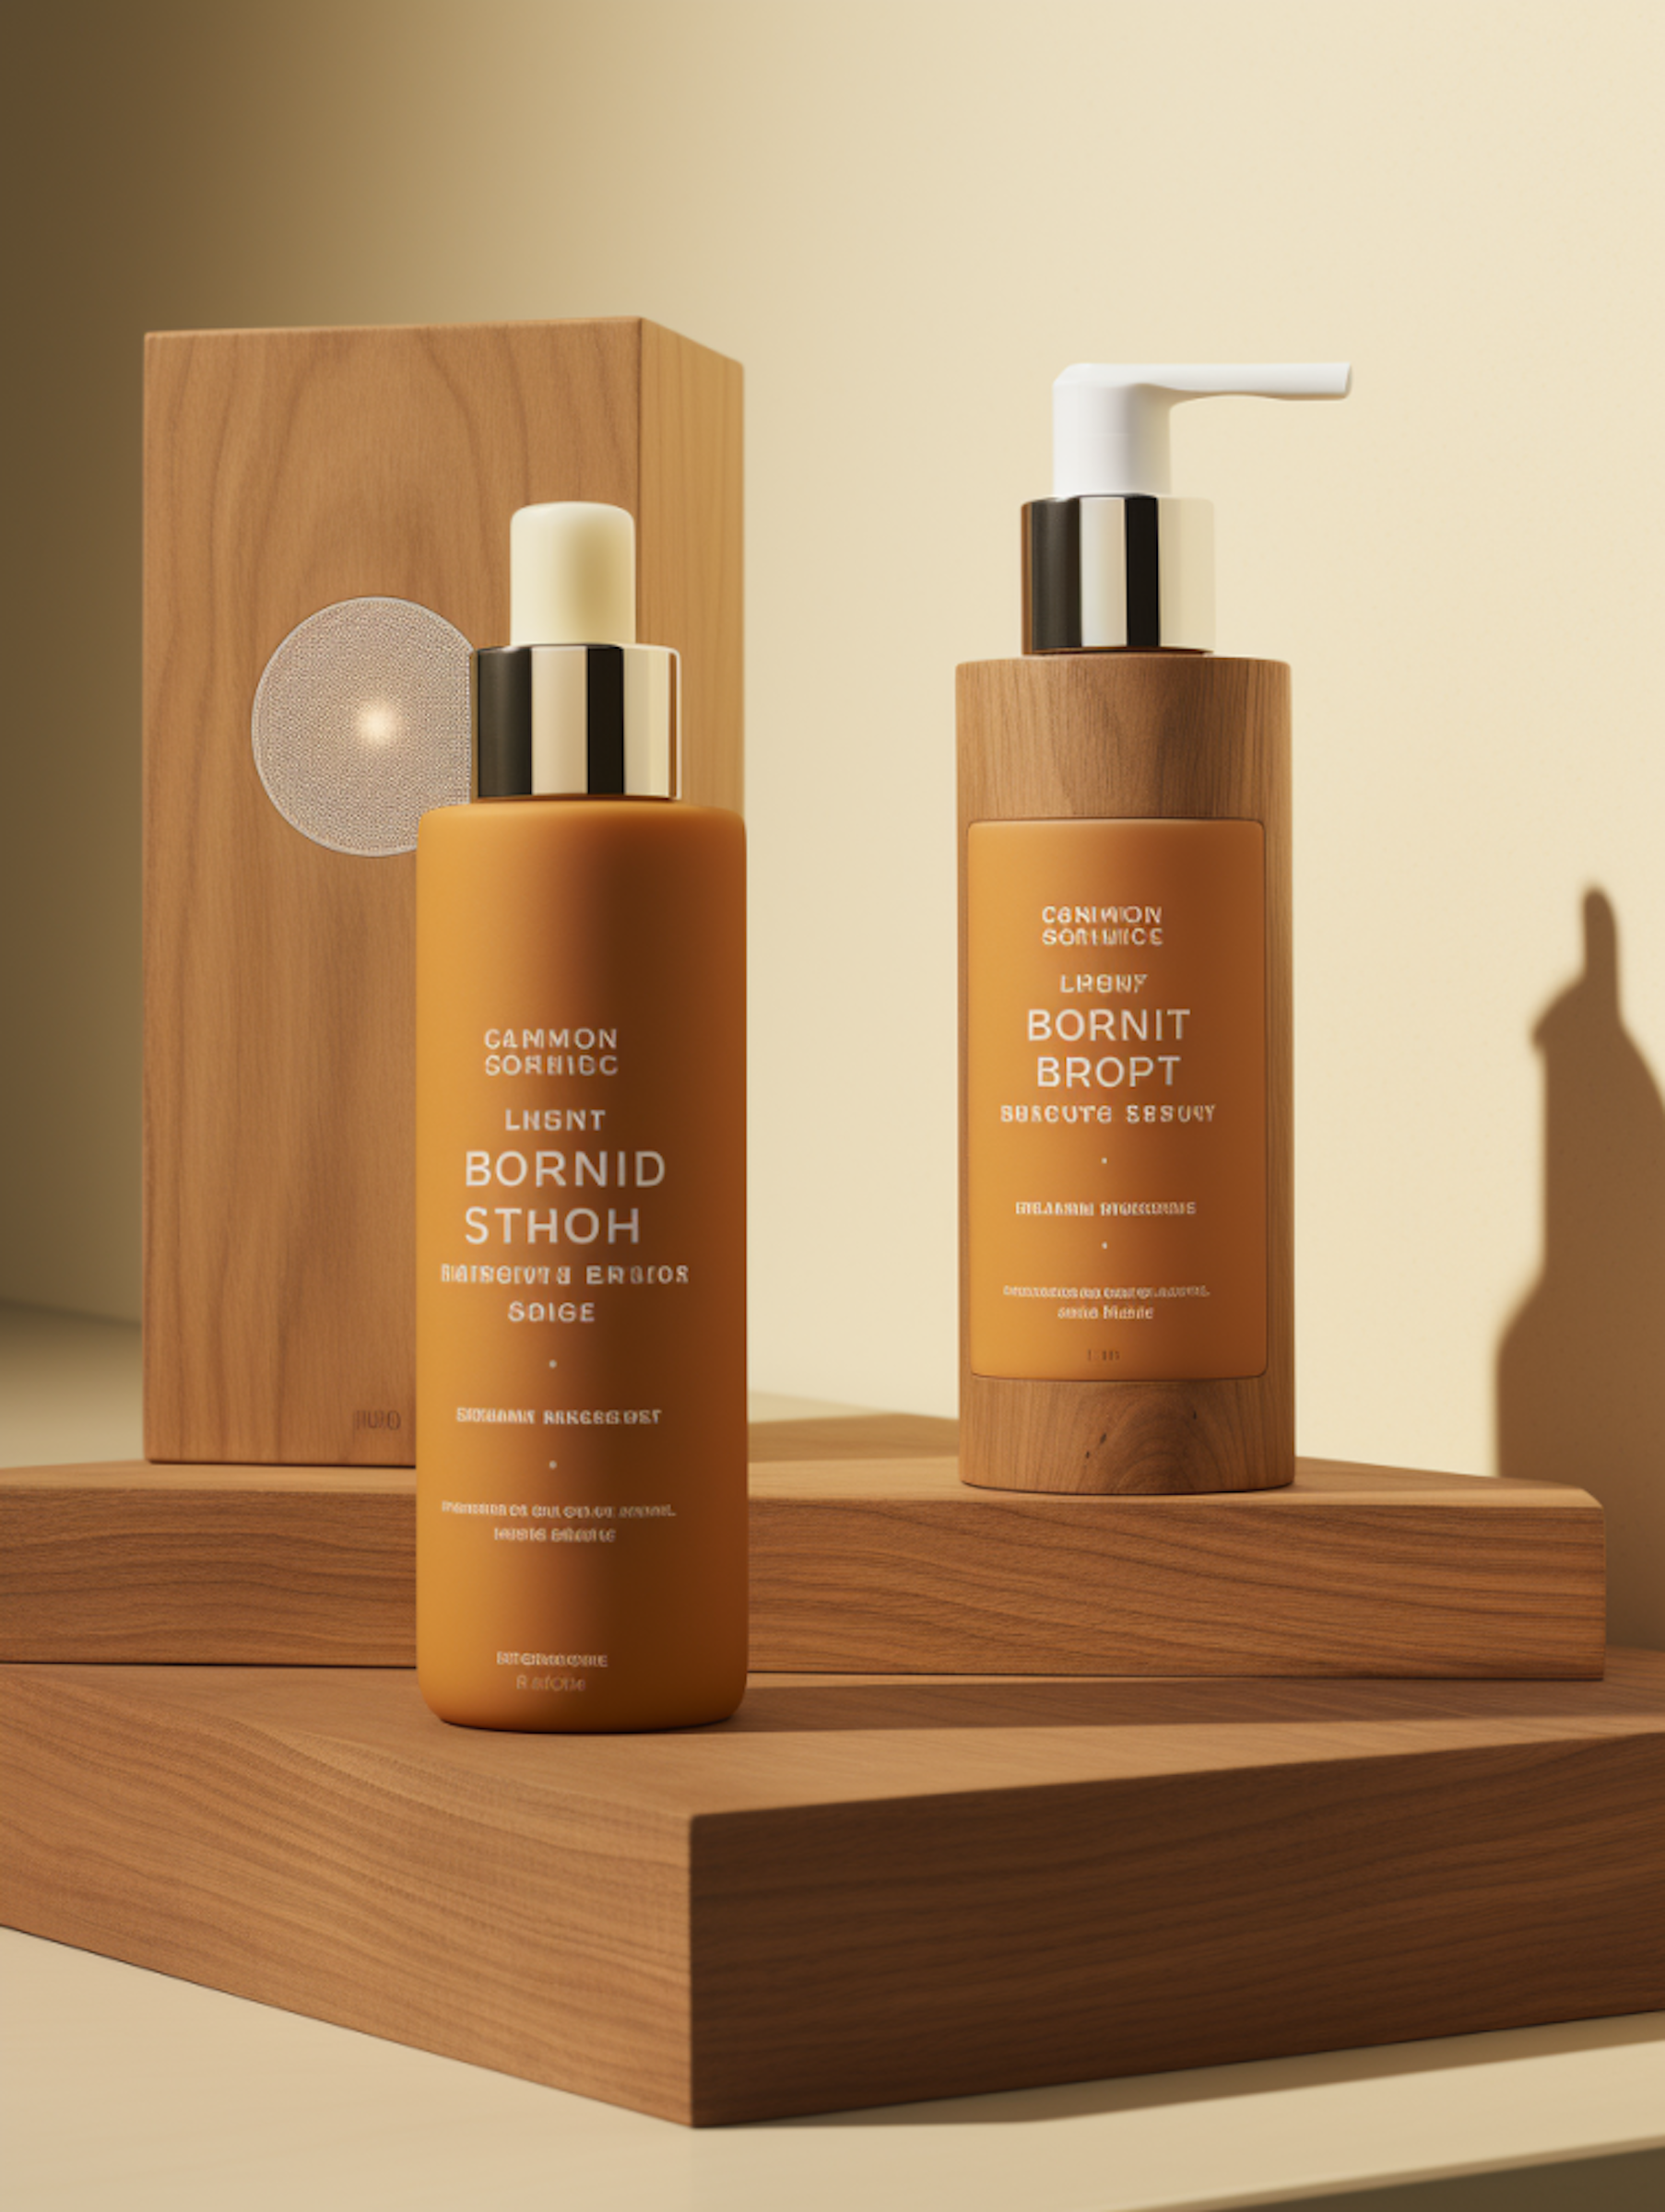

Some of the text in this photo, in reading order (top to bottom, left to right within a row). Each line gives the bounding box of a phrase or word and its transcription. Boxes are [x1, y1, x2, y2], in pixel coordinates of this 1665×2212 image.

[1027, 1008, 1191, 1041] BORNIT
[1037, 1055, 1181, 1088] BROPT
[465, 1149, 666, 1187] BORNID
[465, 1206, 640, 1245] STHOH
